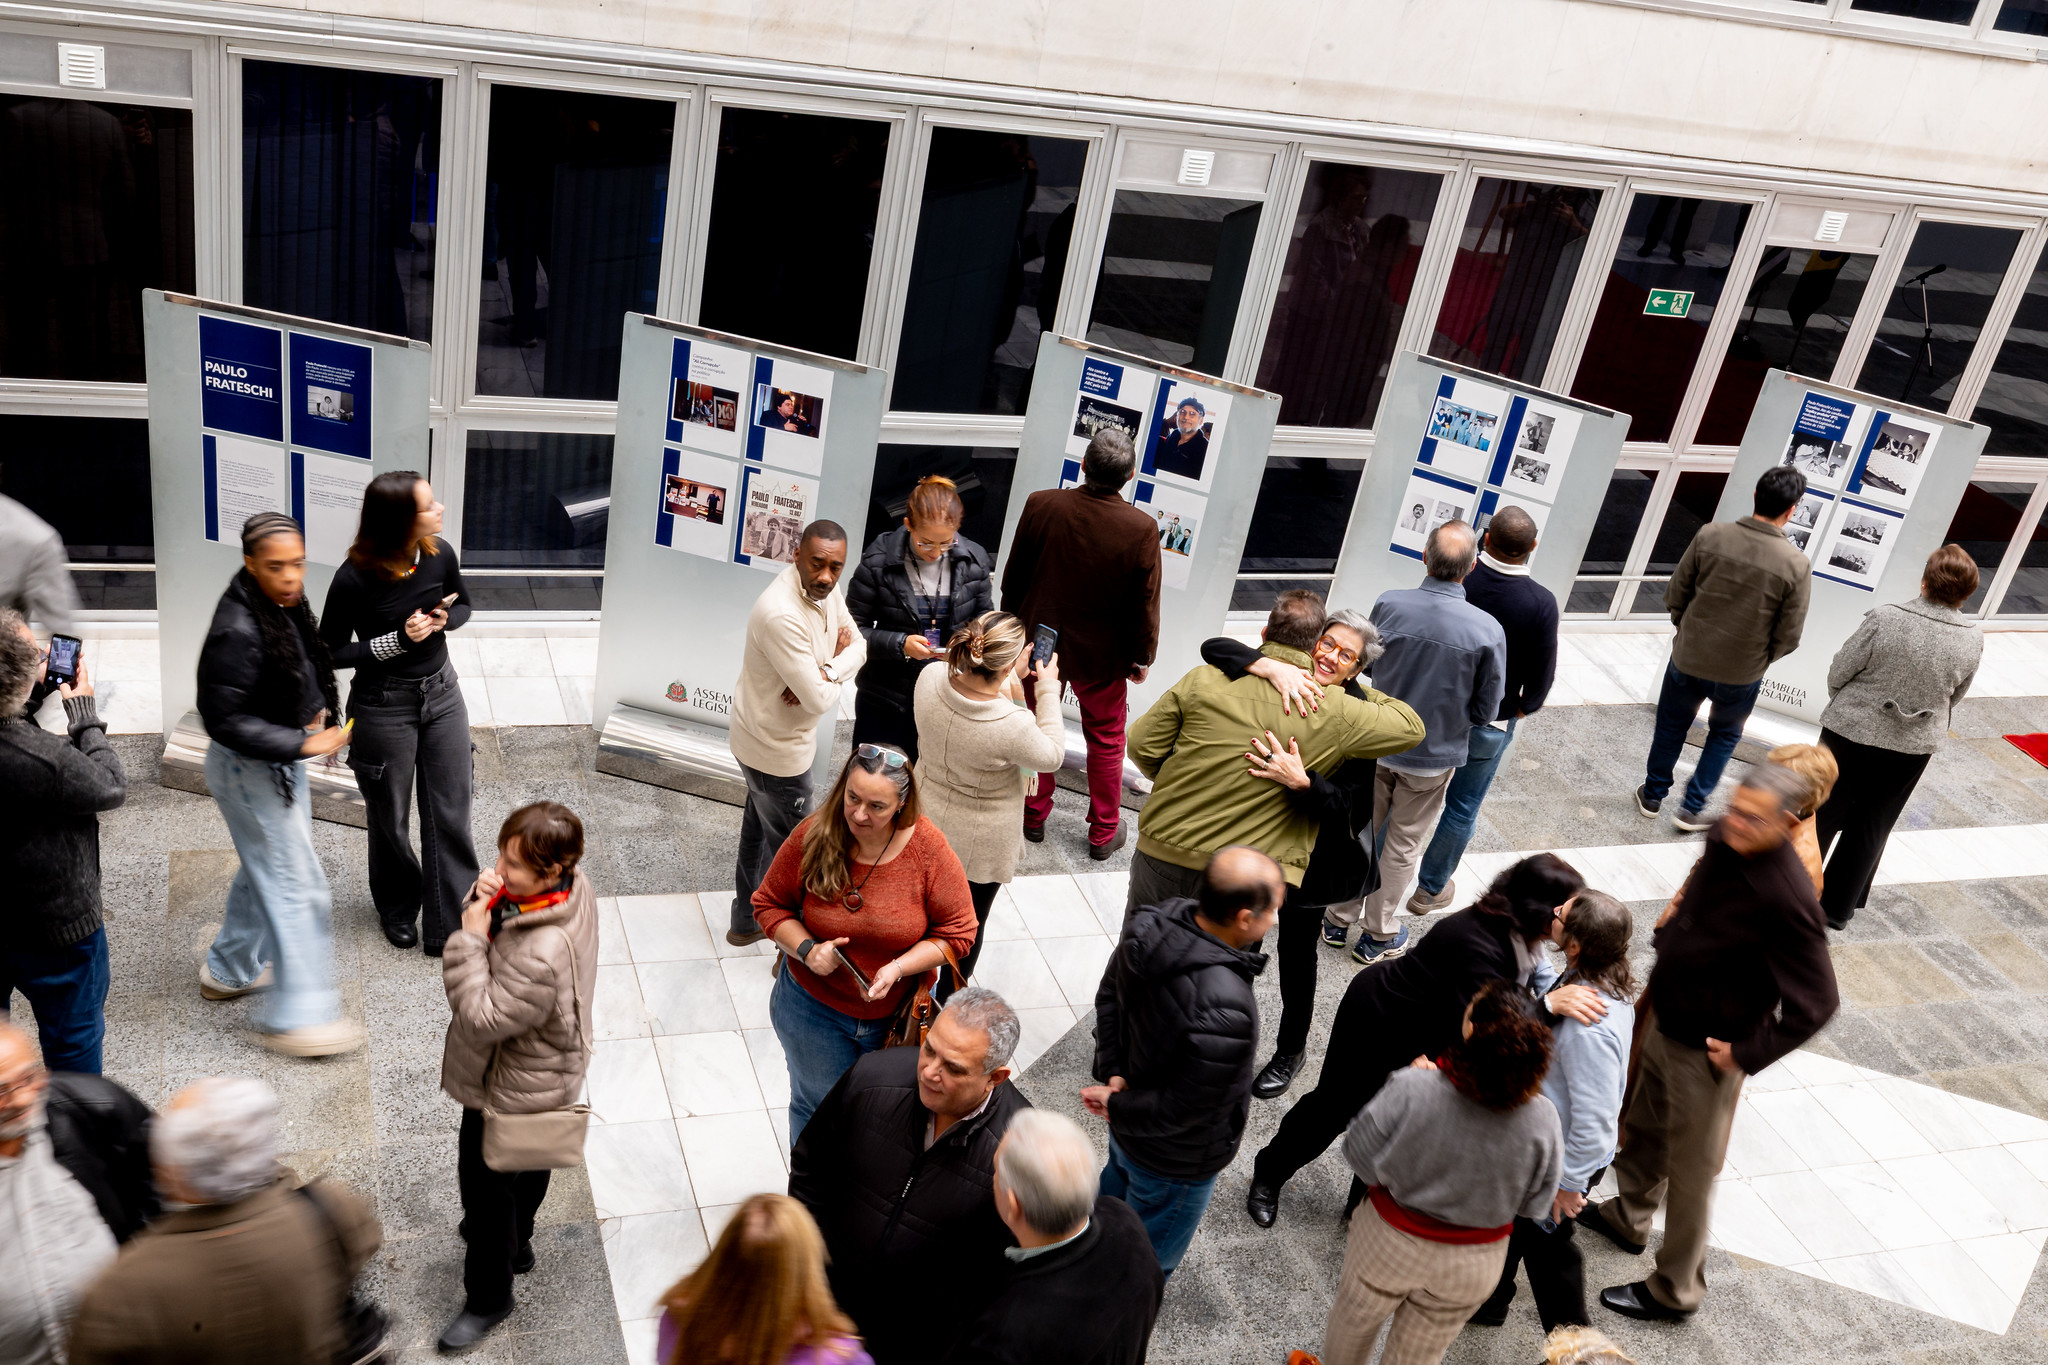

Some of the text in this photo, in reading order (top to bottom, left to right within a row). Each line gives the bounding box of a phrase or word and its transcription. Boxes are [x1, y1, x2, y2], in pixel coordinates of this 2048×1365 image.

[205, 361, 248, 379] PAULO
[205, 376, 273, 399] FRATESCHI
[751, 490, 803, 511] PAULO FRATESCHI
[693, 687, 732, 705] ASSEM
[1760, 688, 1802, 707] ISLATIVA
[1761, 679, 1806, 699] SEMBLEIA
[693, 697, 731, 715] LEGISL
